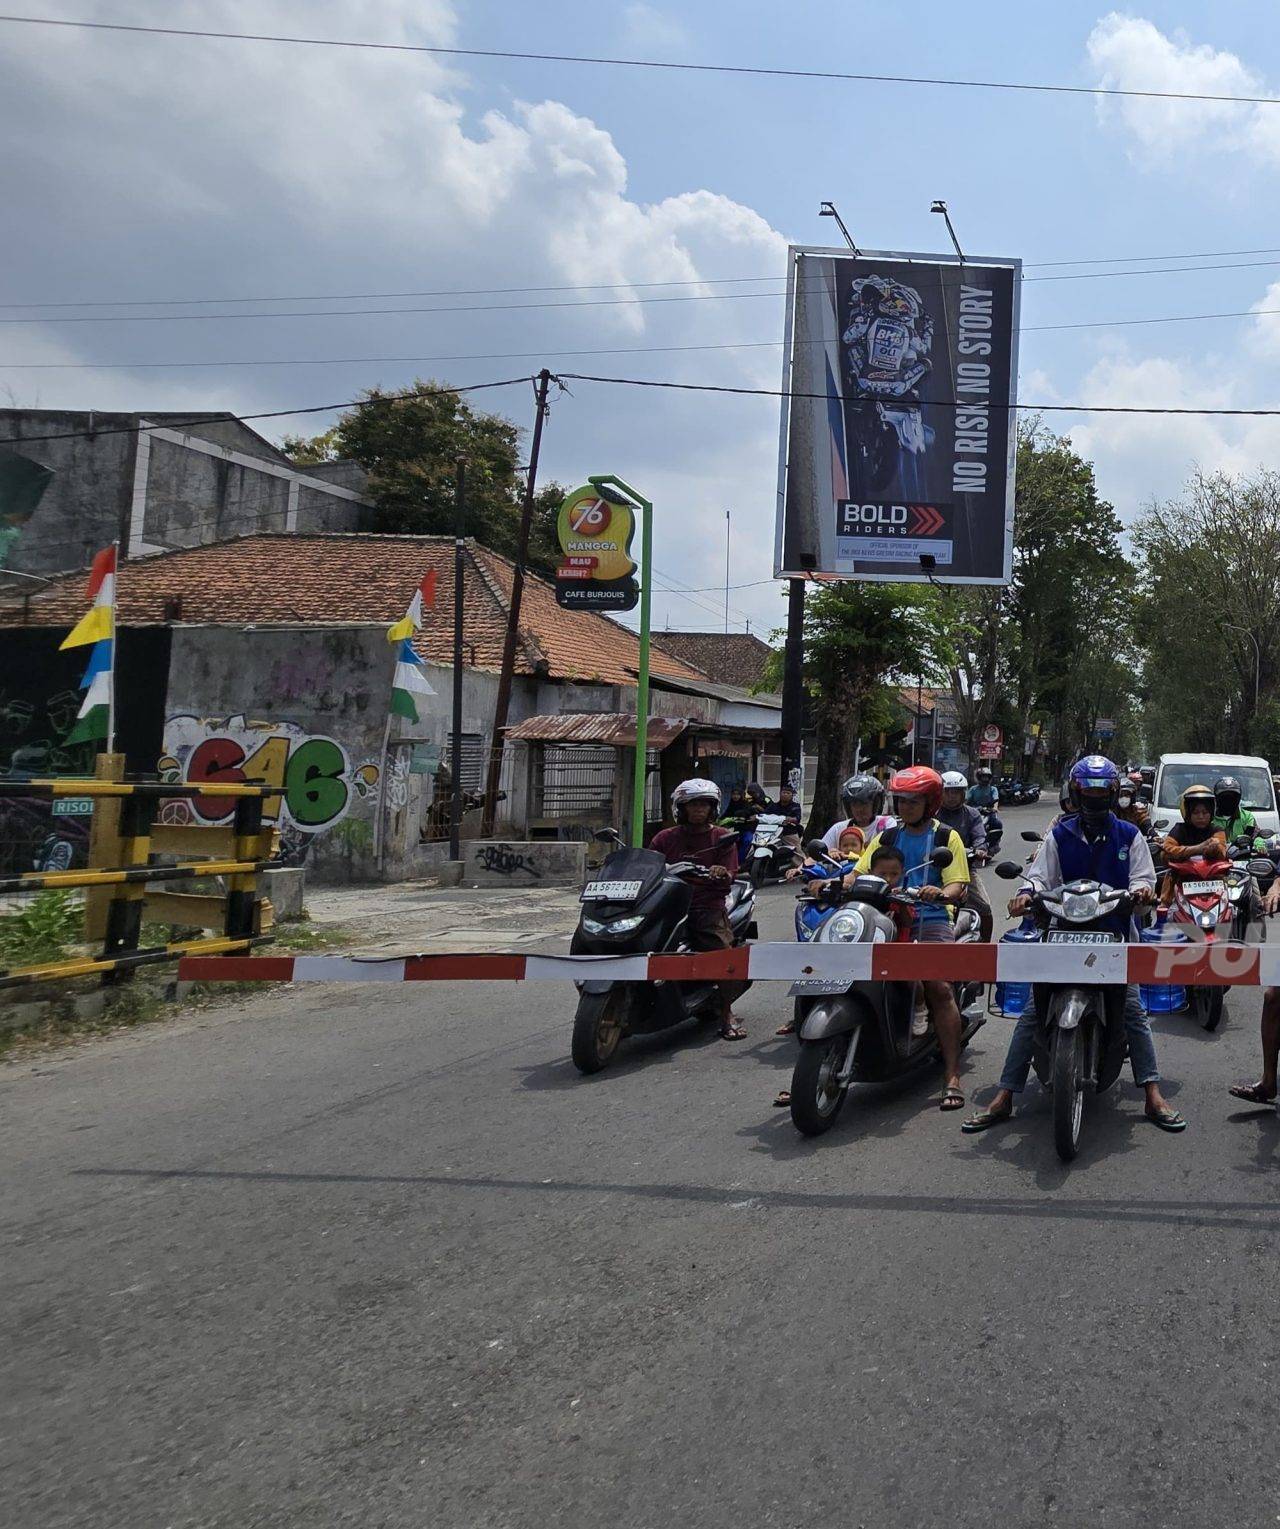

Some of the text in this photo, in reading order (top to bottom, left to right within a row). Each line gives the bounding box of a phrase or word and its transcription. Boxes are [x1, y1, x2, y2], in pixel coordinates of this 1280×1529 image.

[953, 285, 993, 493] NO RISK NO STORY
[573, 499, 603, 531] 76
[844, 504, 907, 524] BOLD
[844, 525, 907, 535] RIDERS
[567, 541, 618, 551] MANGGA
[587, 883, 598, 891] AA
[1051, 933, 1064, 943] AA
[1067, 933, 1094, 944] 2042
